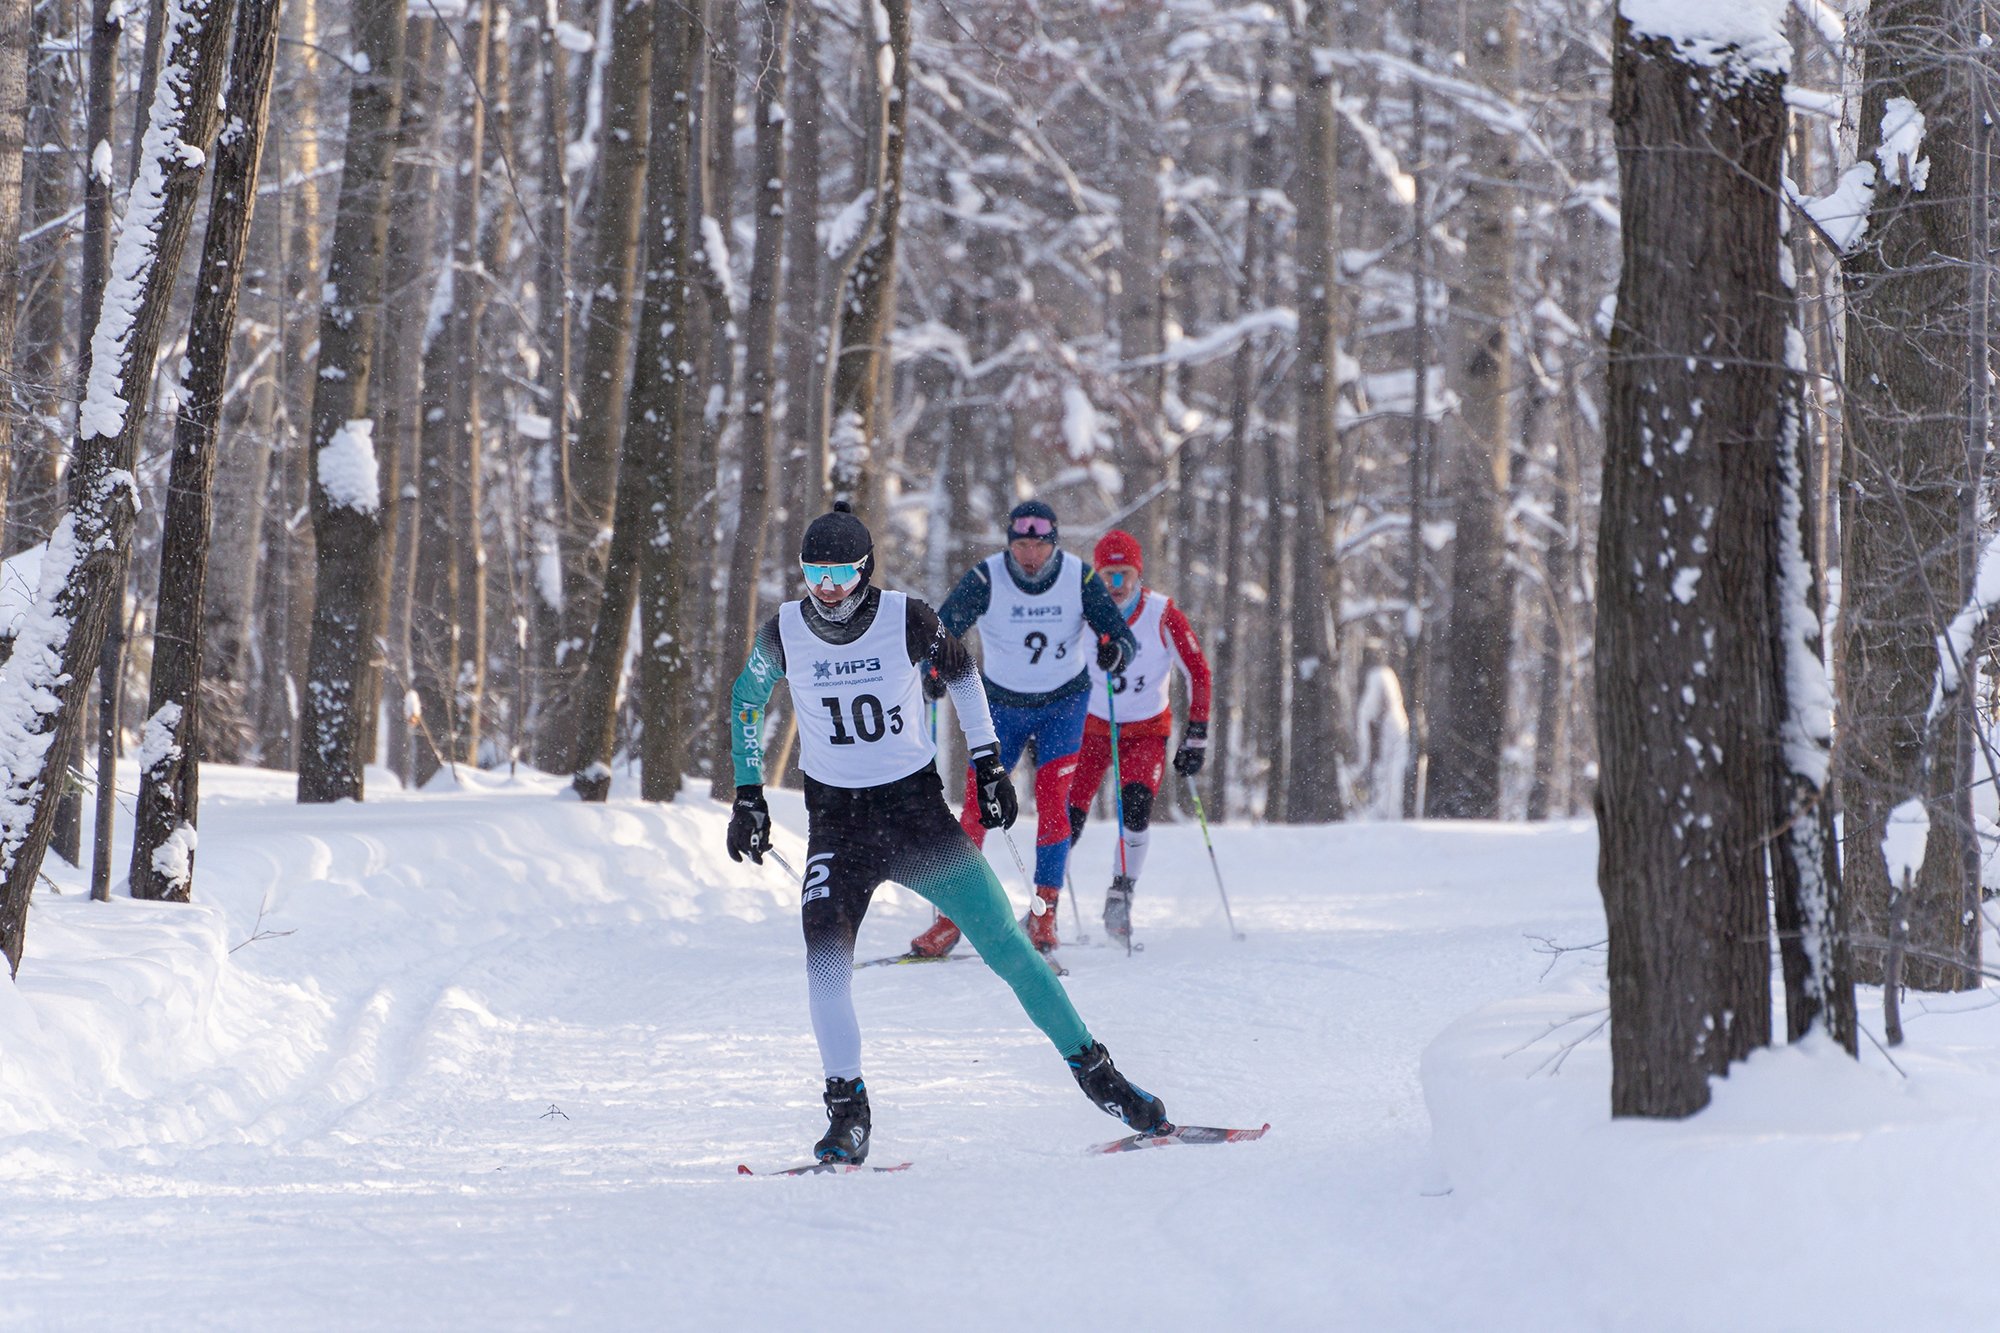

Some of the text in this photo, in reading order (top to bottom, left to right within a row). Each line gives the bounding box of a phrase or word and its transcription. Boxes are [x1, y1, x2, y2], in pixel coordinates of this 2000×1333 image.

[1028, 605, 1062, 616] ИРЗ
[1024, 631, 1067, 664] 9 3
[834, 657, 881, 675] ИРЗ
[844, 675, 884, 686] РАДИОЗАВОД
[821, 693, 904, 745] 10 3
